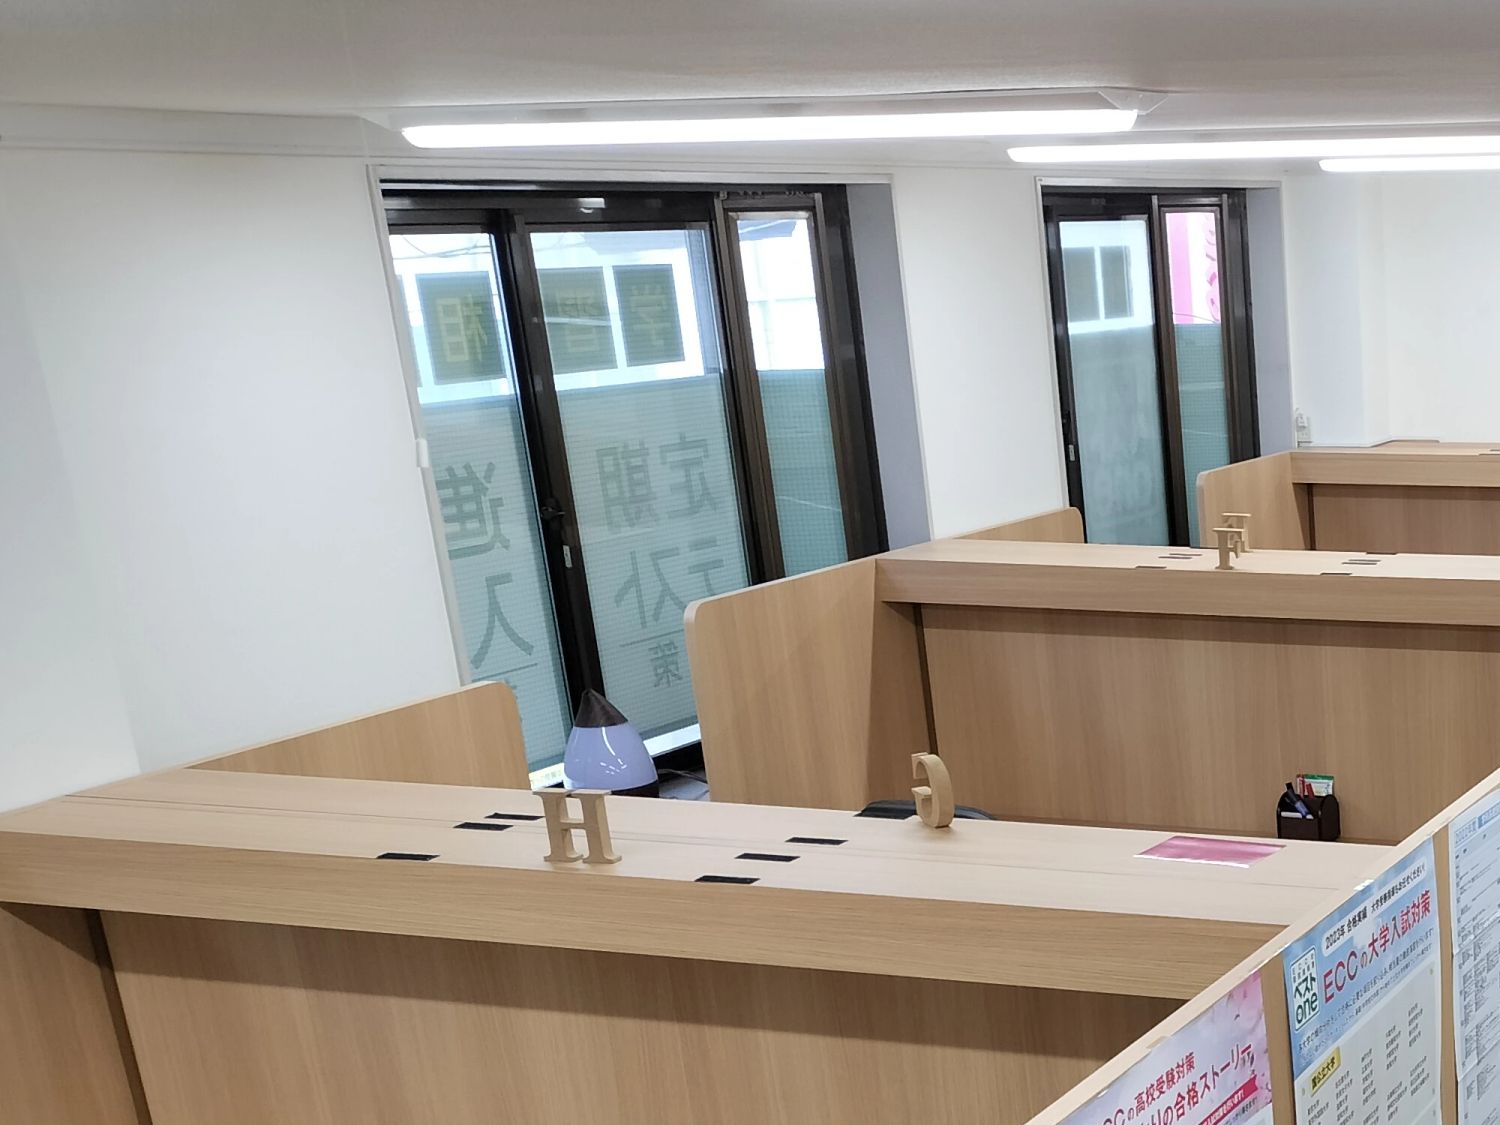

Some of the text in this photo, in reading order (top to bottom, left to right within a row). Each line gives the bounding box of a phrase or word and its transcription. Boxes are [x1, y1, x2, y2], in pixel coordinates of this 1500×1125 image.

[1212, 527, 1245, 571] F
[532, 787, 623, 864] H
[1323, 888, 1432, 1004] ECCの大学入試対策
[1293, 969, 1316, 1000] ベスト
[1296, 992, 1318, 1024] one
